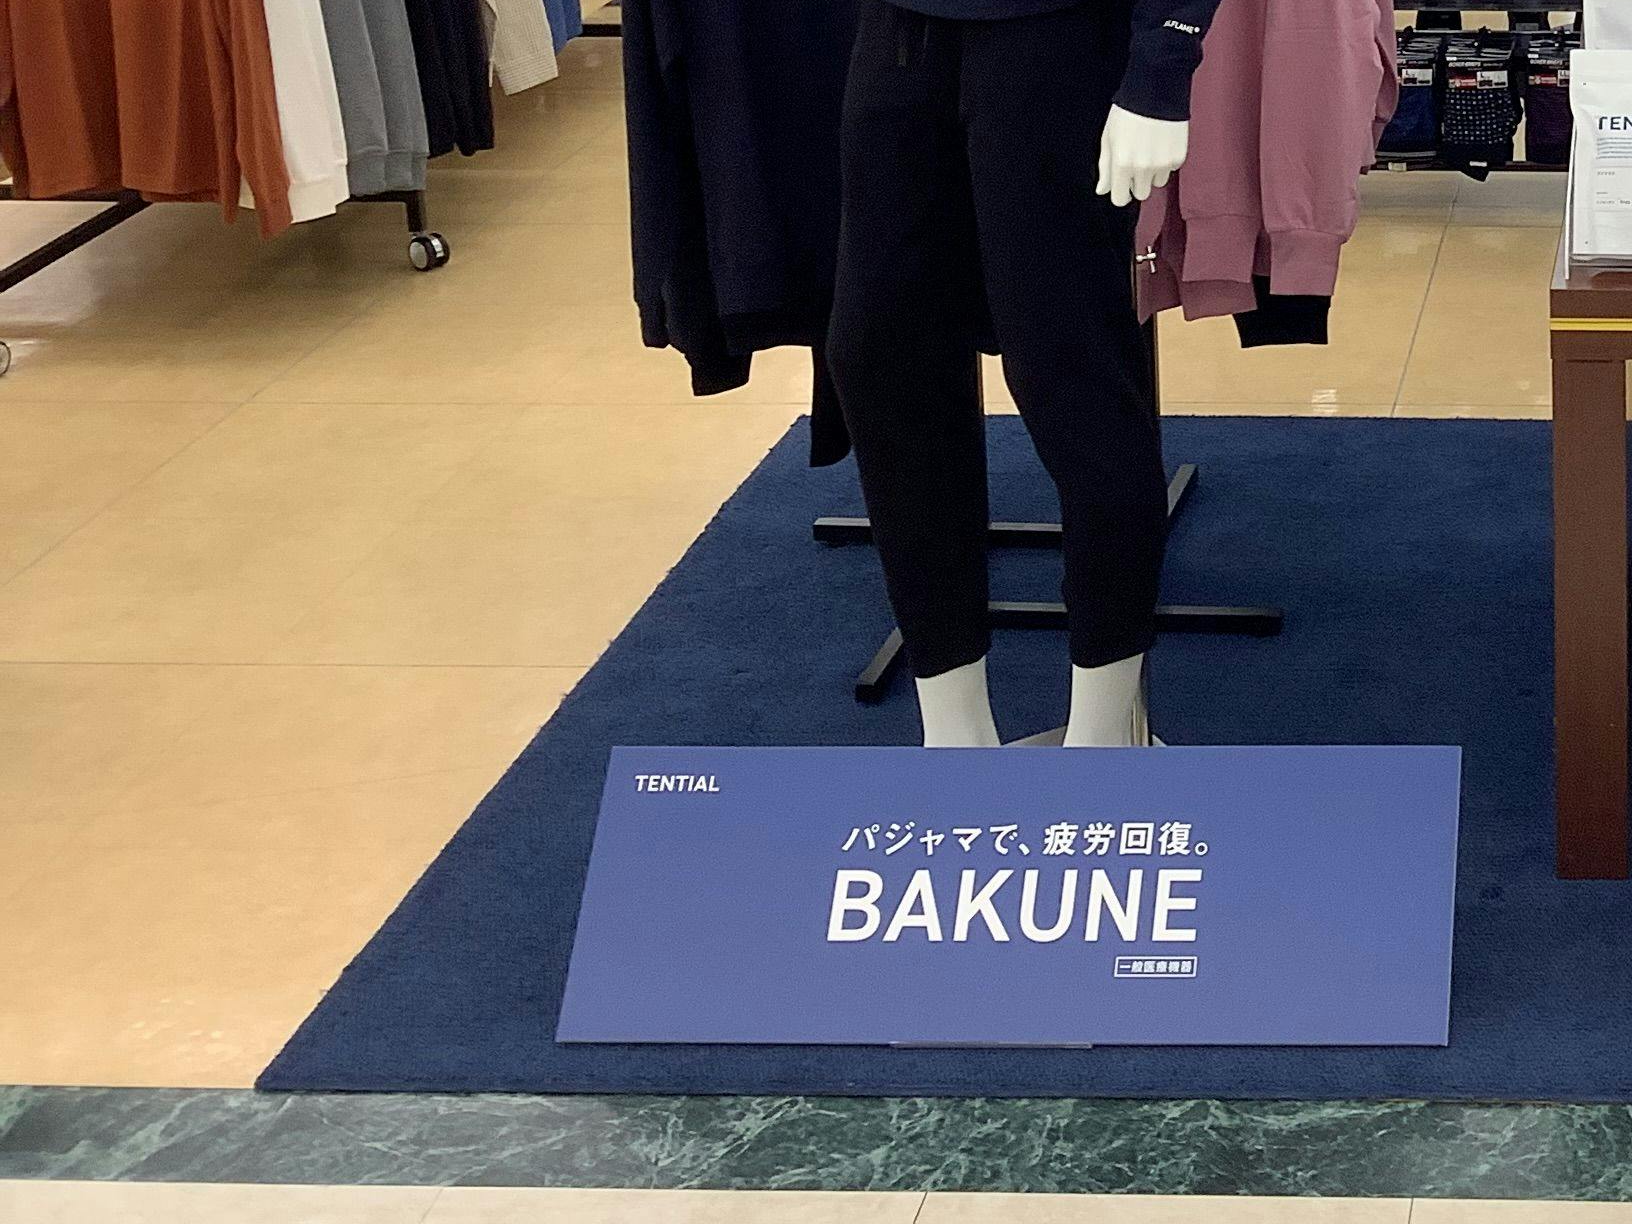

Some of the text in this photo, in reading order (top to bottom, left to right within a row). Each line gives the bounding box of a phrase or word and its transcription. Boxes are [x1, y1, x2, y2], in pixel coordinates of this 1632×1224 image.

[635, 775, 720, 793] TENTIAL
[842, 822, 1209, 856] パジャマで、疲労回復。
[827, 869, 1202, 942] BAKUNE
